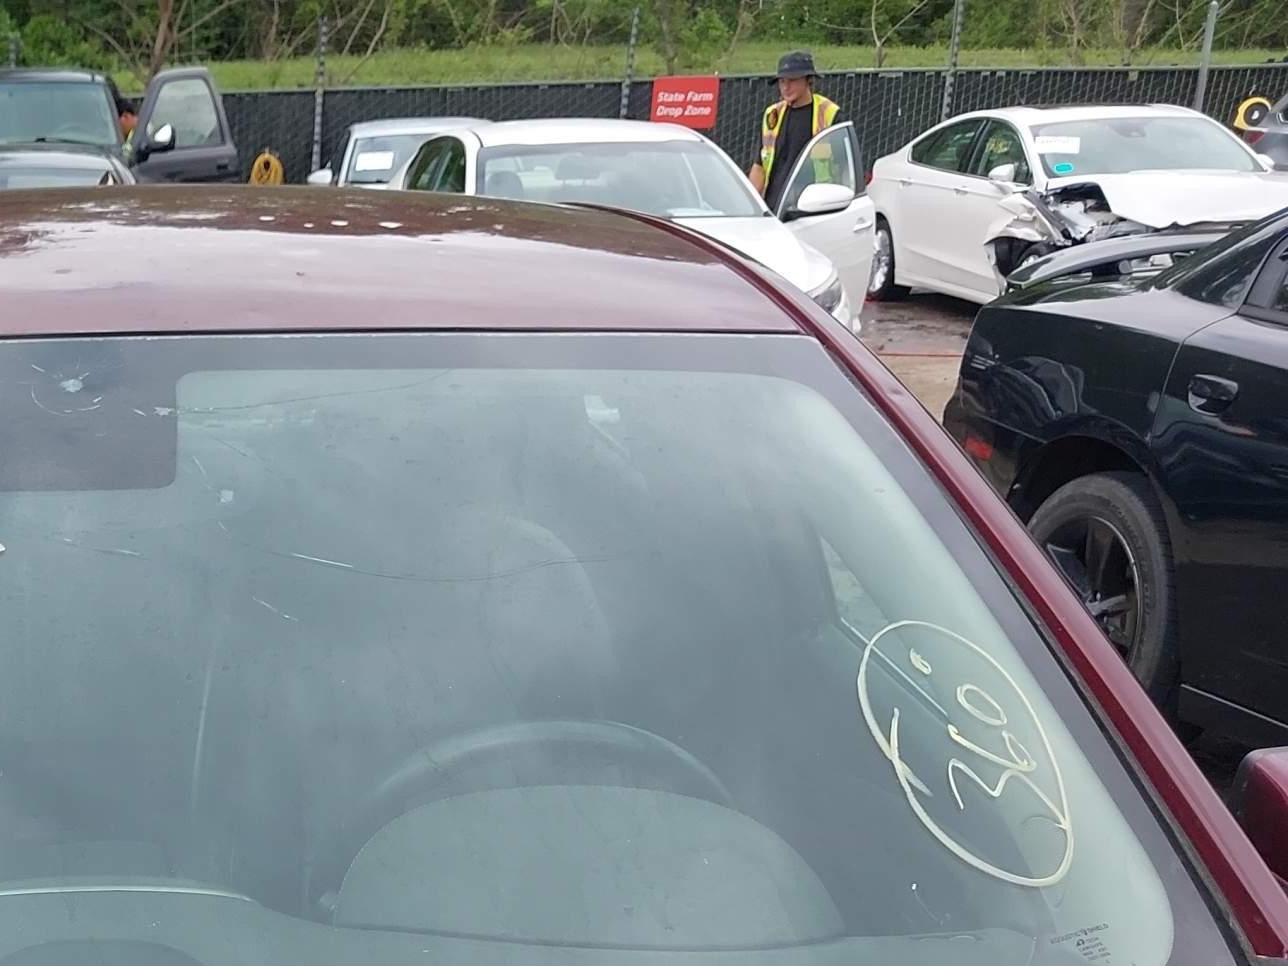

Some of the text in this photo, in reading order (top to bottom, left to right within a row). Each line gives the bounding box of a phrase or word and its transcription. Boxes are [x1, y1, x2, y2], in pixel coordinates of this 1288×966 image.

[657, 91, 713, 102] State Farm
[656, 105, 711, 118] Drop Zone
